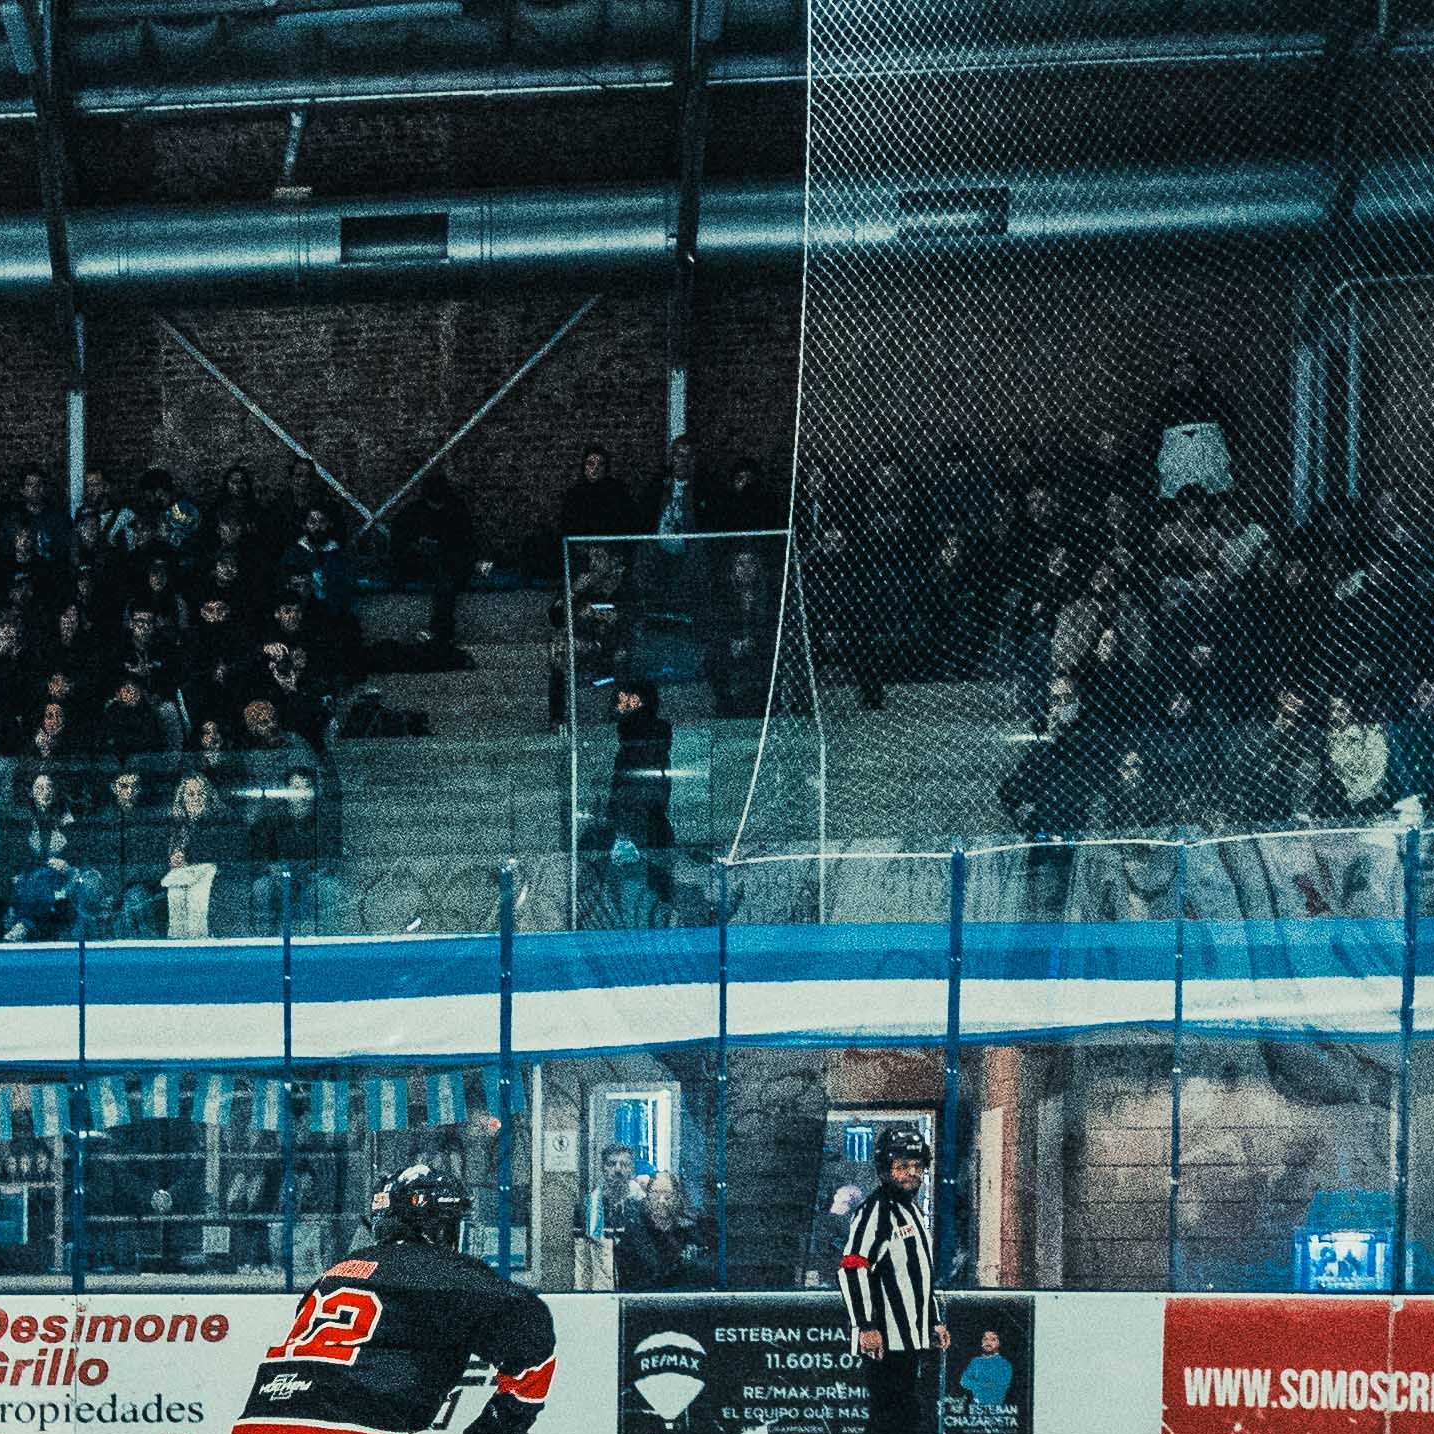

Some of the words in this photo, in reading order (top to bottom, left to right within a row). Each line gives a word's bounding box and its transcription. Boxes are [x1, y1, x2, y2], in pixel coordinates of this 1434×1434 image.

[715, 1326, 801, 1343] ESTEBAN
[807, 1327, 851, 1343] CHA
[640, 1353, 700, 1372] RE/MAX
[742, 1385, 809, 1400] RE/MAX
[815, 1384, 871, 1401] PREMI
[721, 1406, 740, 1419] EL
[743, 1406, 799, 1421] EQUIPO
[803, 1406, 834, 1420] QUE
